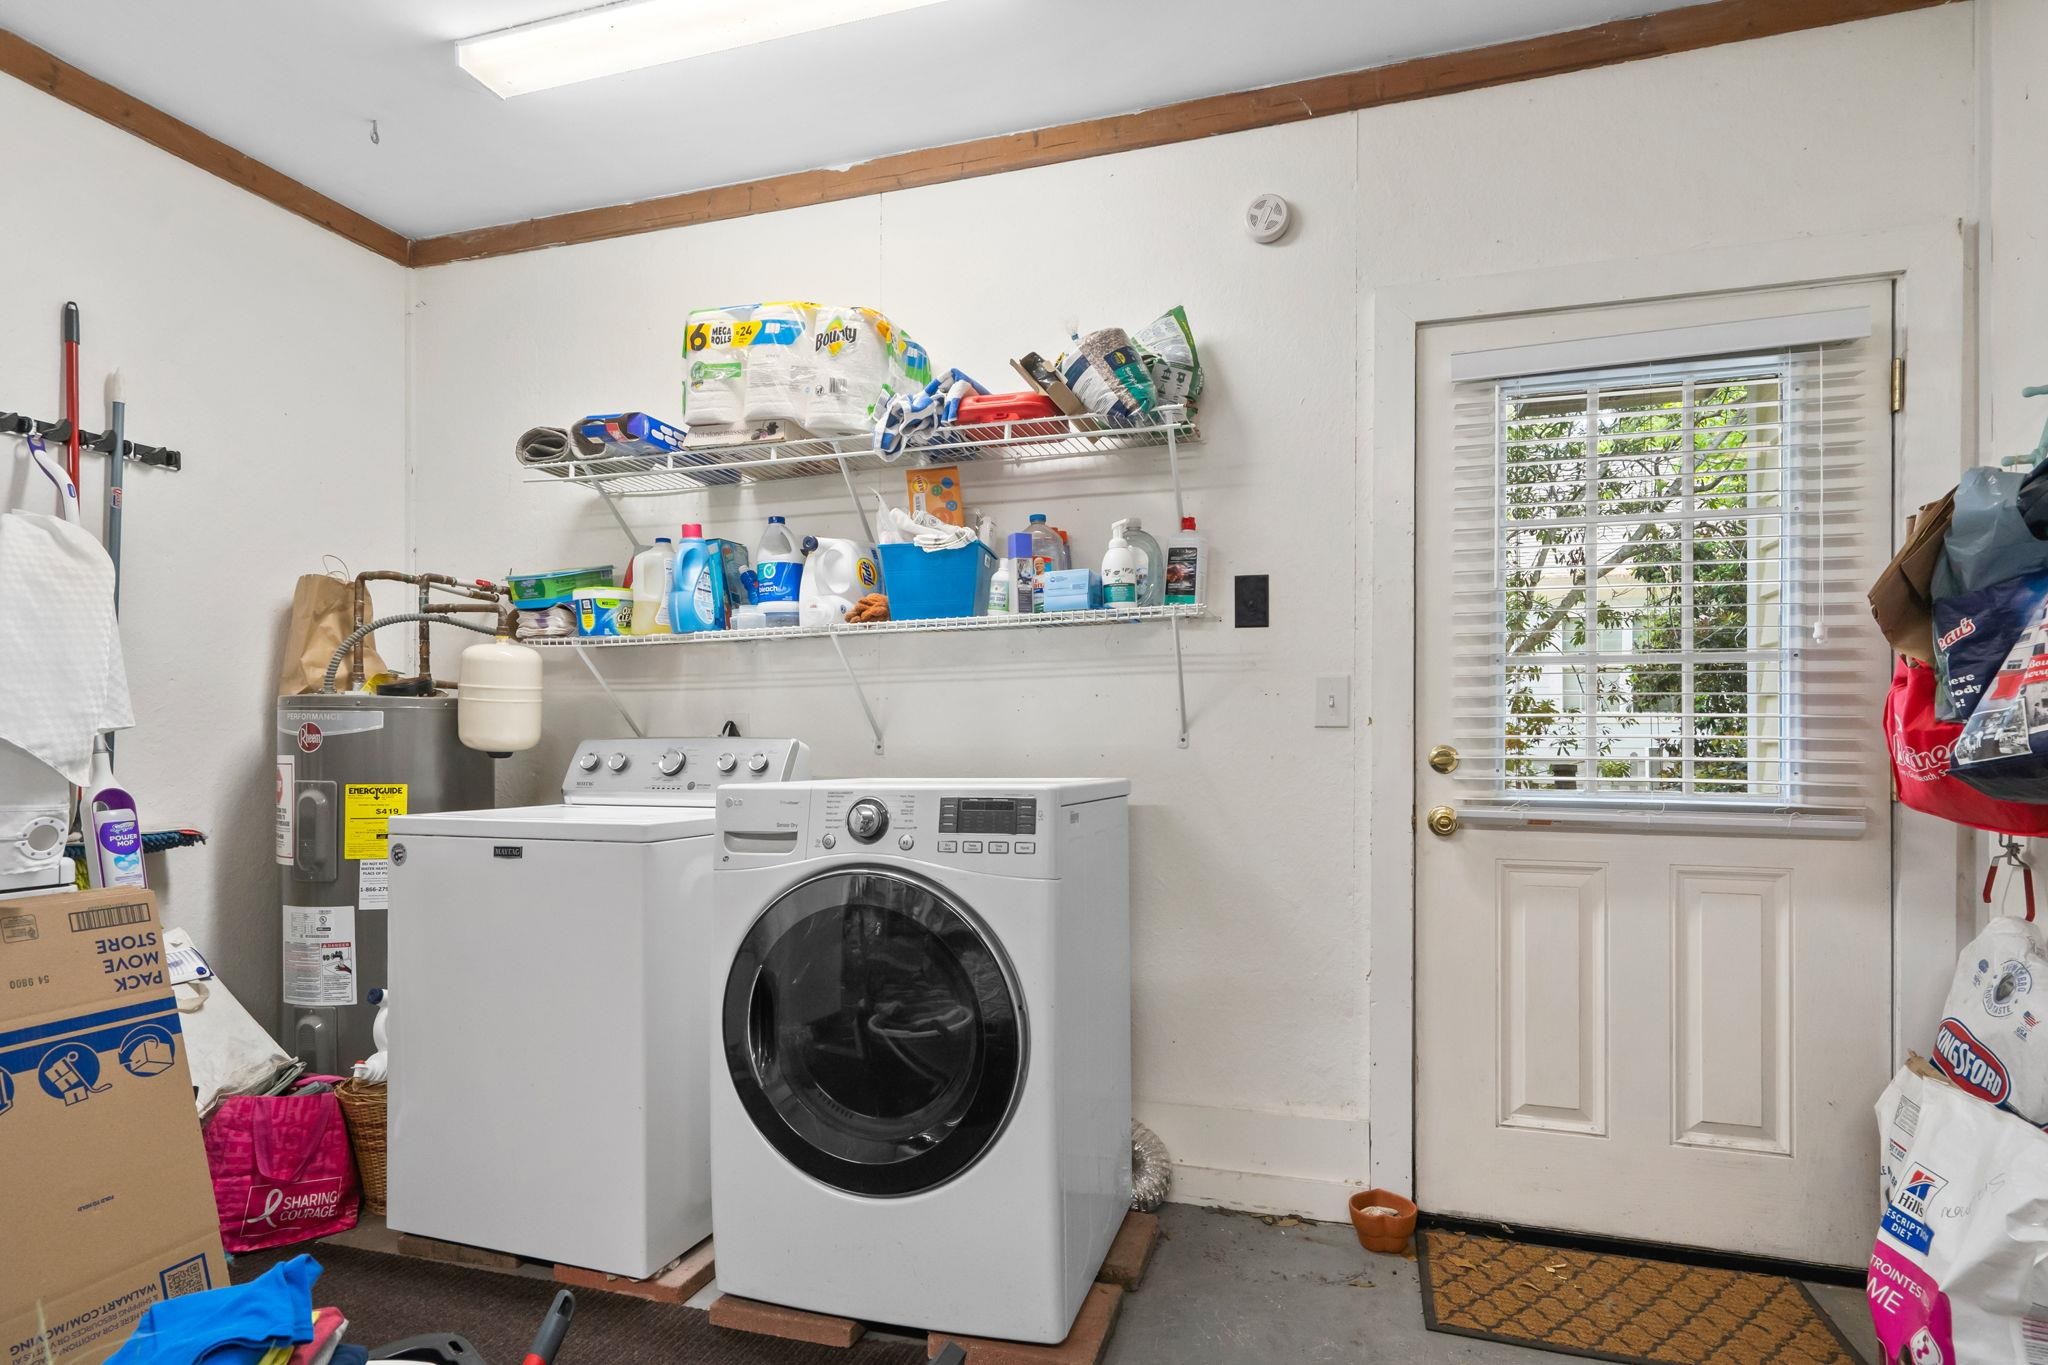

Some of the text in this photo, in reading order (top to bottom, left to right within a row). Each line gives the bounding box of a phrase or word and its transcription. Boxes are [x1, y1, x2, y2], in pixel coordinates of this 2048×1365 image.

[690, 323, 706, 351] 6
[711, 335, 732, 345] ROLLS
[712, 327, 731, 336] MEGA
[740, 325, 752, 337] 24
[815, 325, 857, 352] Bounty
[861, 561, 875, 585] Tide
[300, 722, 320, 748] Rheem
[110, 833, 138, 842] POWER
[494, 848, 520, 856] MAYTAG
[95, 932, 157, 954] STORE
[103, 951, 159, 974] MOVE
[114, 970, 163, 992] PACK
[1936, 1027, 2002, 1097] KINGSFORD
[282, 1191, 338, 1210] SHARING
[1898, 1192, 1925, 1218] Hill's
[1891, 1222, 1913, 1240] DIET
[1867, 1277, 1904, 1315] ME
[71, 1313, 117, 1339] RESOURCES
